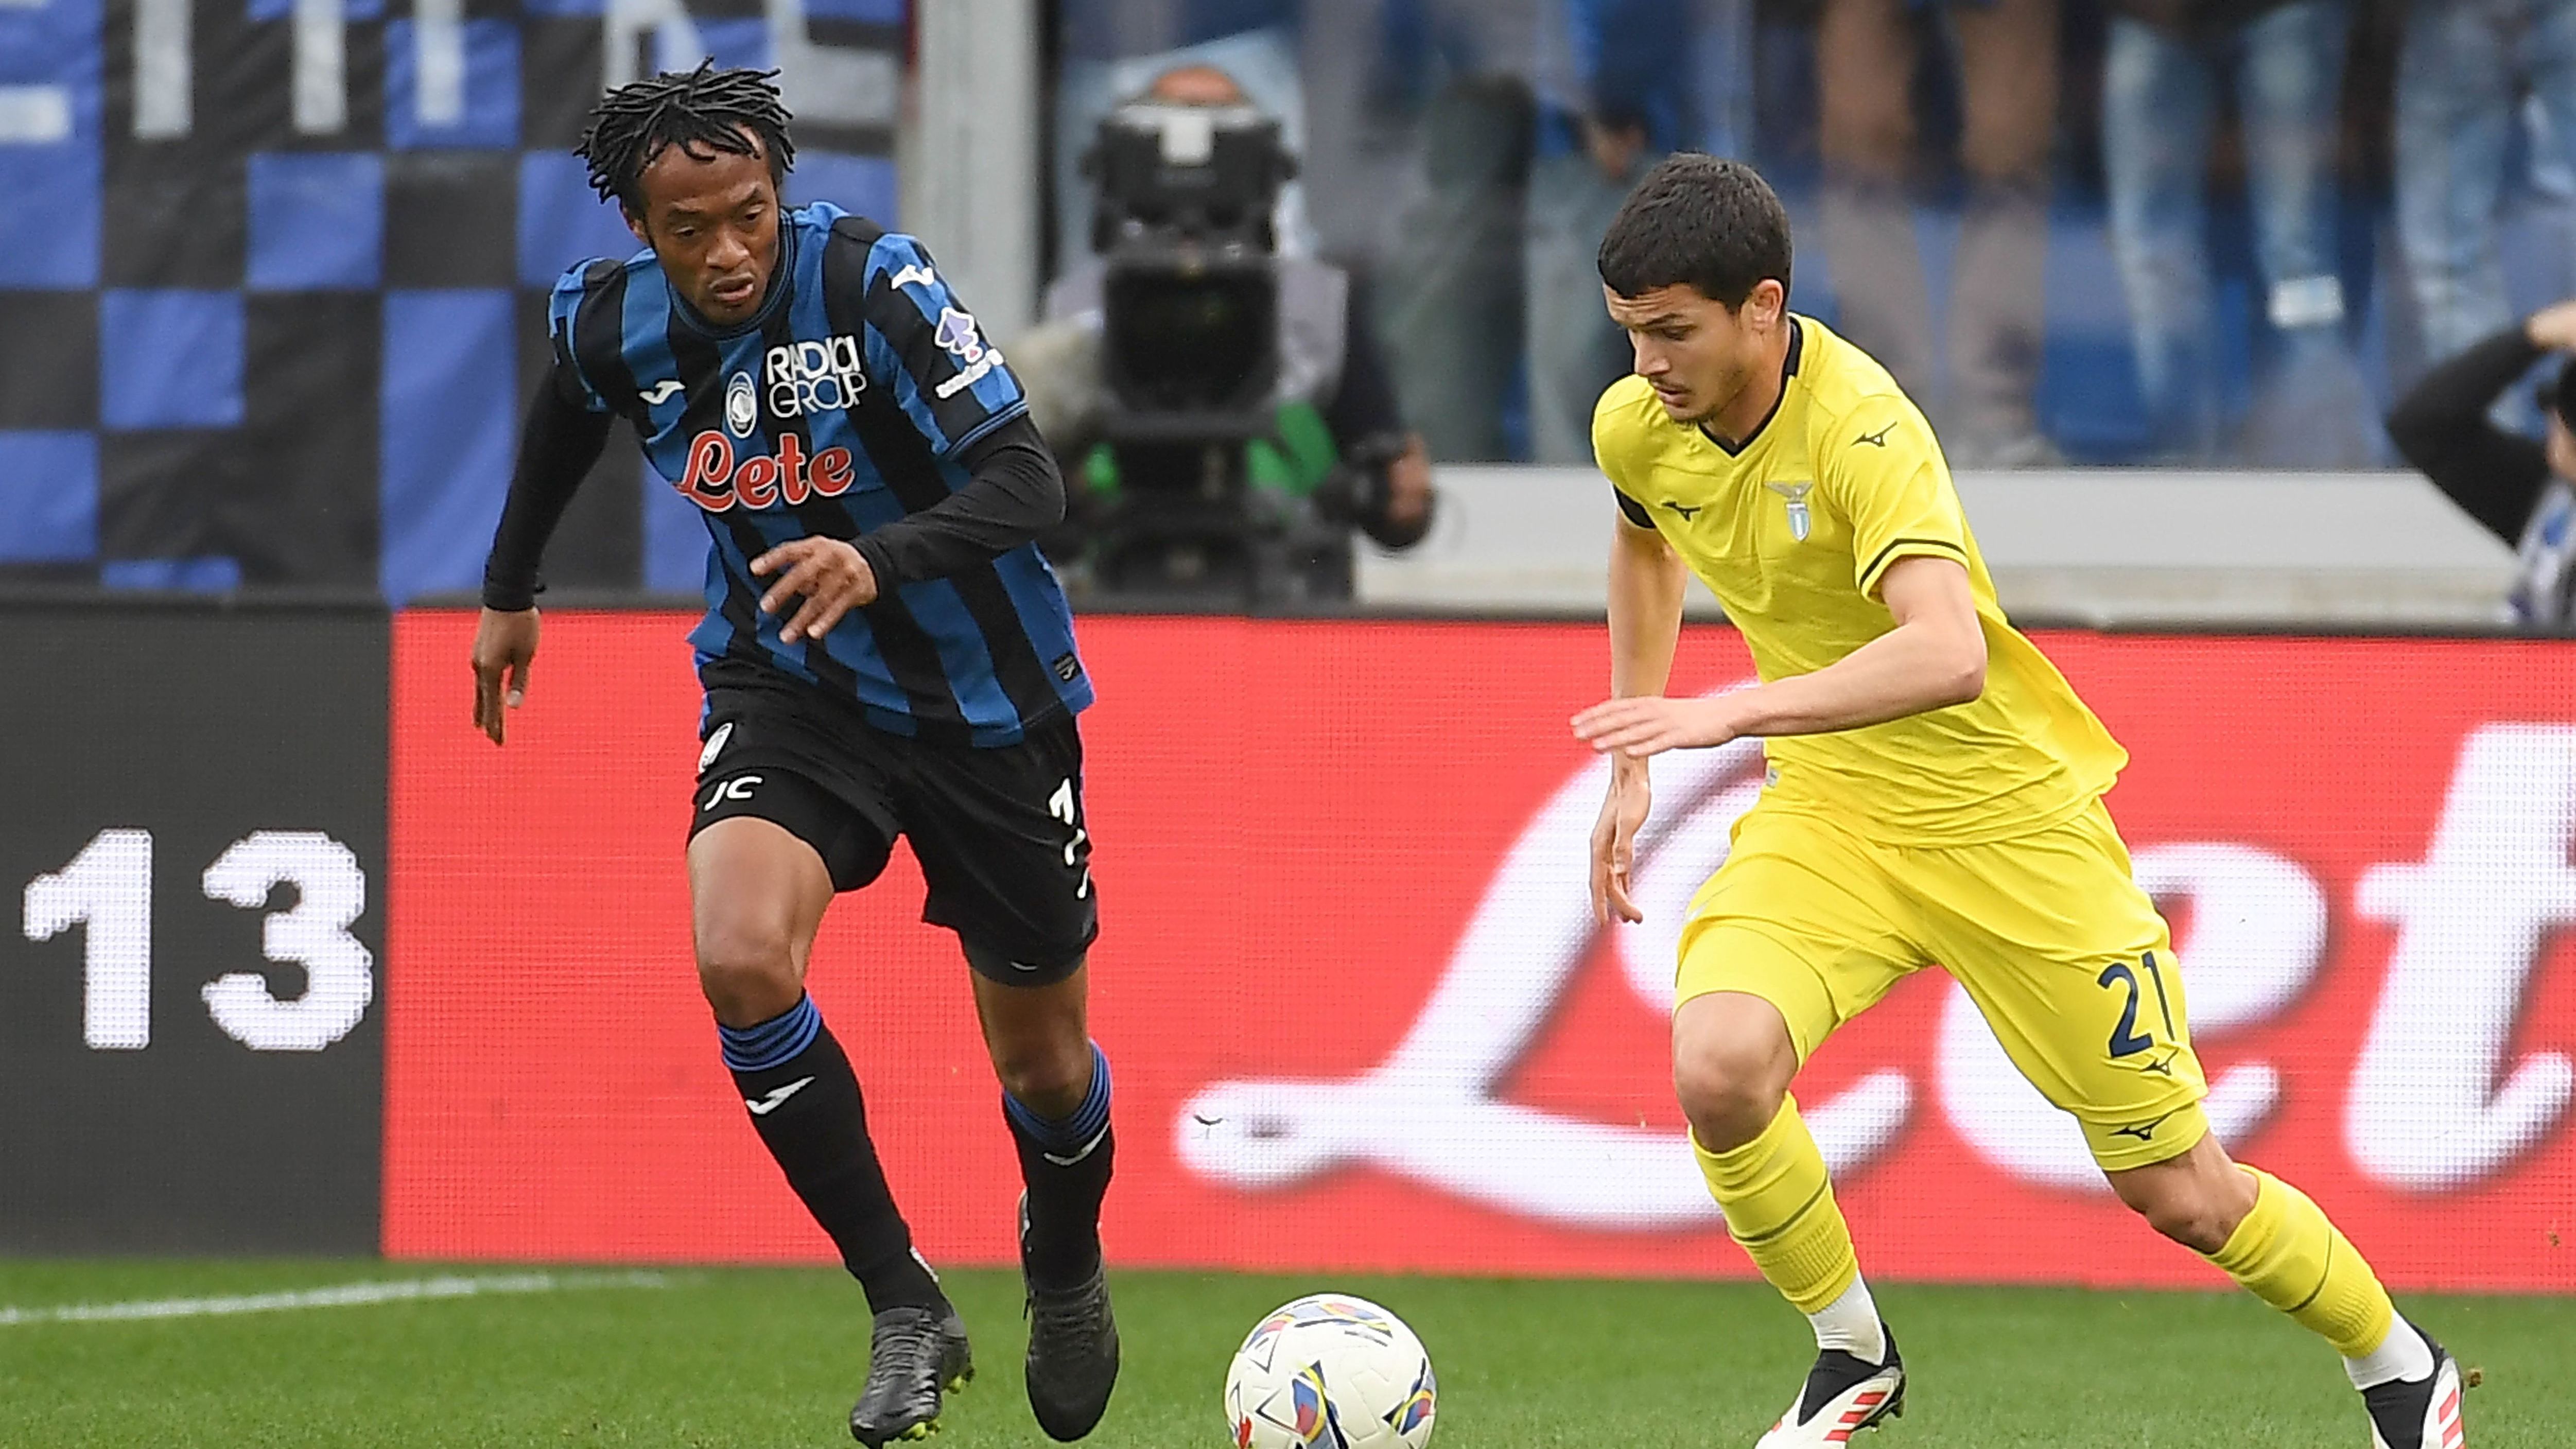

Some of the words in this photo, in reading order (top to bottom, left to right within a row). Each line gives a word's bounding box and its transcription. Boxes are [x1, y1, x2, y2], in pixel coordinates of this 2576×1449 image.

[767, 335, 861, 386] RADICI
[769, 372, 867, 418] GROUP
[672, 430, 856, 512] Lete
[24, 827, 373, 1052] 13
[2097, 950, 2175, 1059] 21
